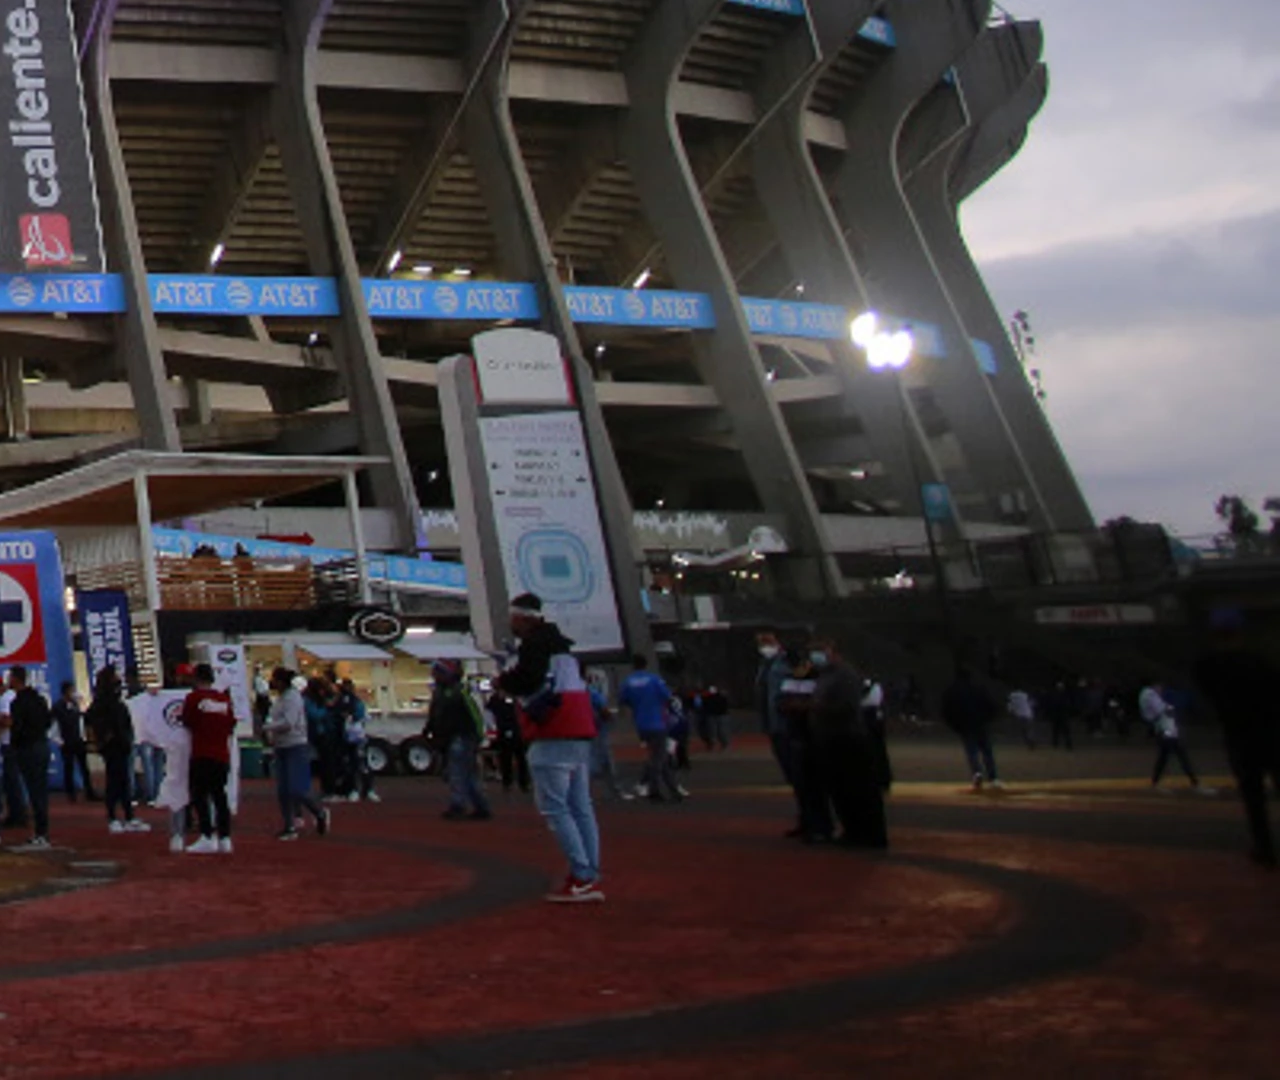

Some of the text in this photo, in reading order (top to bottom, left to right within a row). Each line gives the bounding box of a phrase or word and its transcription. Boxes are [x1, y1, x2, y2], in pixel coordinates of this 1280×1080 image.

[42, 280, 104, 305] AT&T
[155, 282, 321, 307] AT&T AT&T
[367, 286, 522, 313] AT&T AT&T
[651, 296, 700, 319] AT&T
